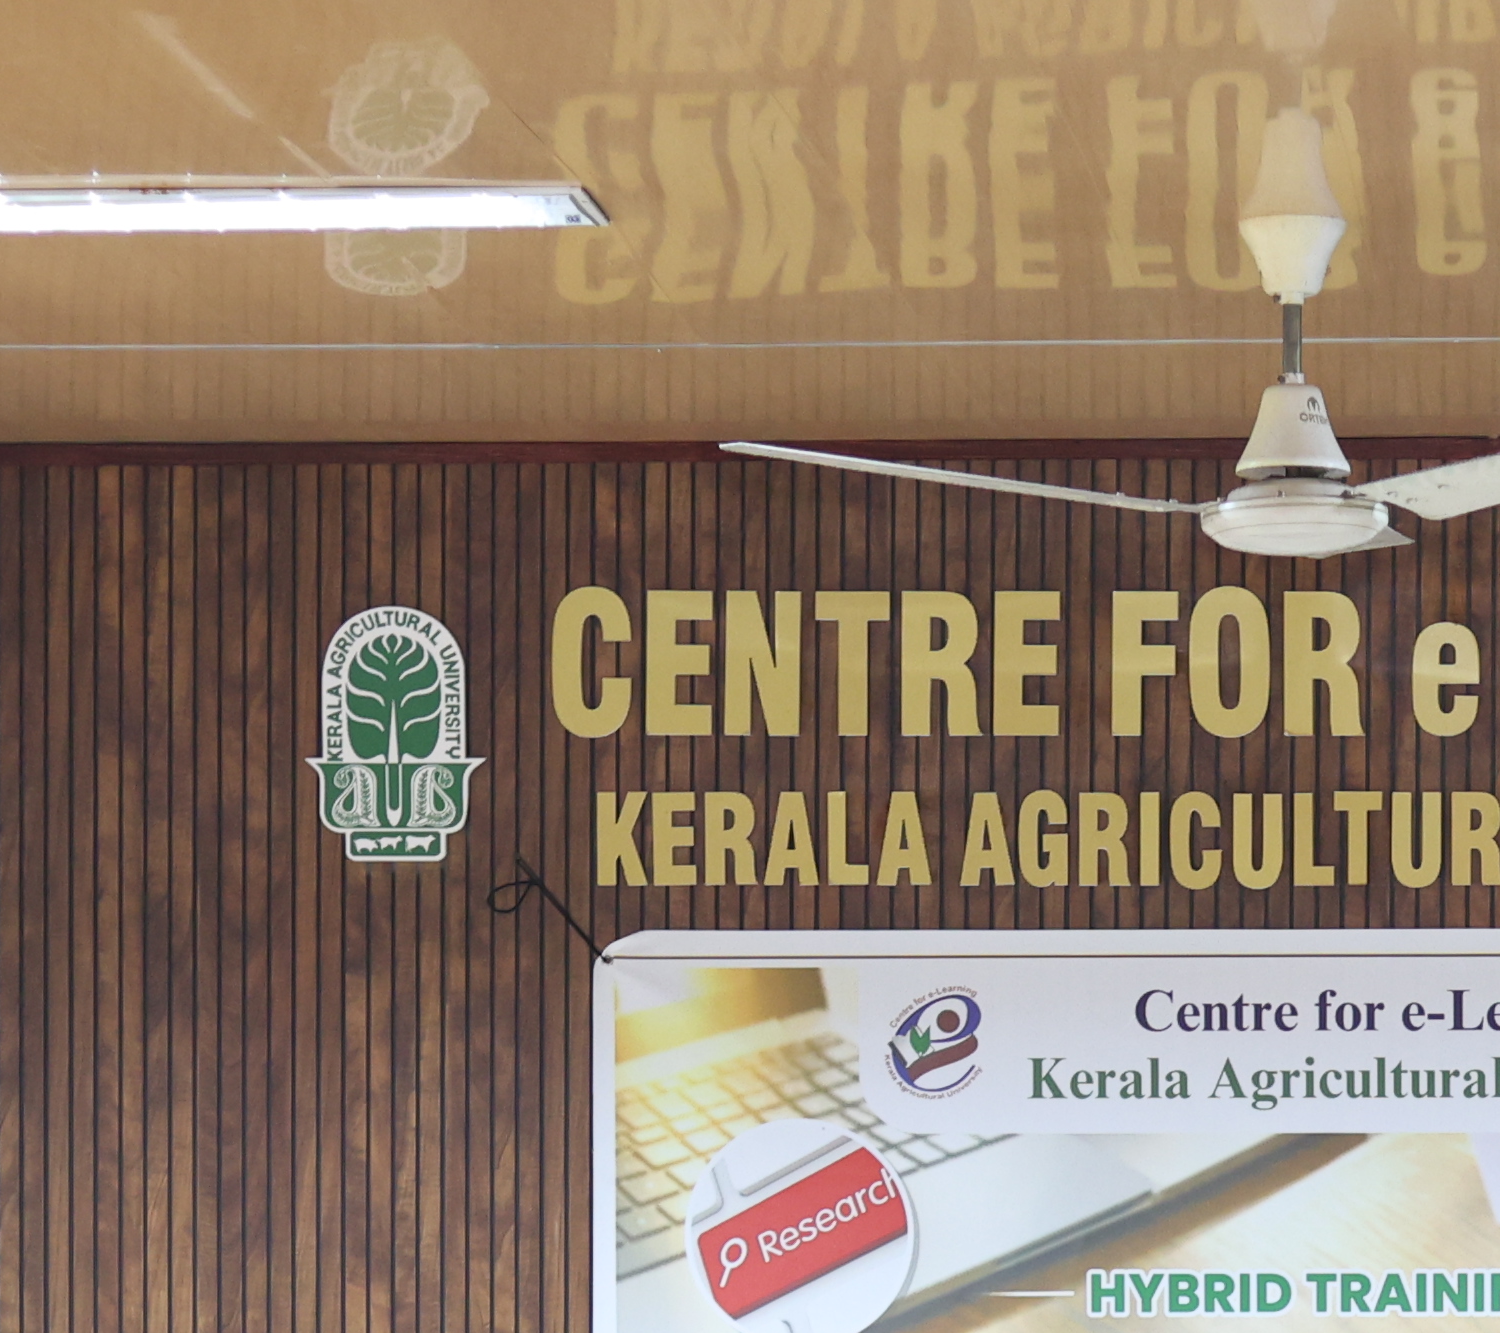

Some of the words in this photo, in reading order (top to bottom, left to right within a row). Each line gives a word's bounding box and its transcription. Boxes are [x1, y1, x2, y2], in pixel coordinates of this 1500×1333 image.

[326, 610, 441, 679] AGRICULTURAL
[551, 586, 1061, 738] CENTRE
[1111, 586, 1366, 738] FOR
[326, 684, 344, 762] KERALA
[439, 644, 461, 760] UNIVERSITY
[595, 790, 934, 888] KERALA
[889, 1003, 914, 1029] Centre
[912, 995, 927, 1005] for
[928, 985, 978, 998] e-Learning
[1134, 989, 1299, 1032] Centre
[1314, 989, 1385, 1031] for
[884, 1054, 898, 1081] Kerala
[897, 1081, 946, 1099] Agricultural
[946, 1066, 983, 1098] University
[1027, 1057, 1191, 1099] Kerala
[757, 1167, 899, 1263] Research
[1089, 1272, 1294, 1314] HYBRID
